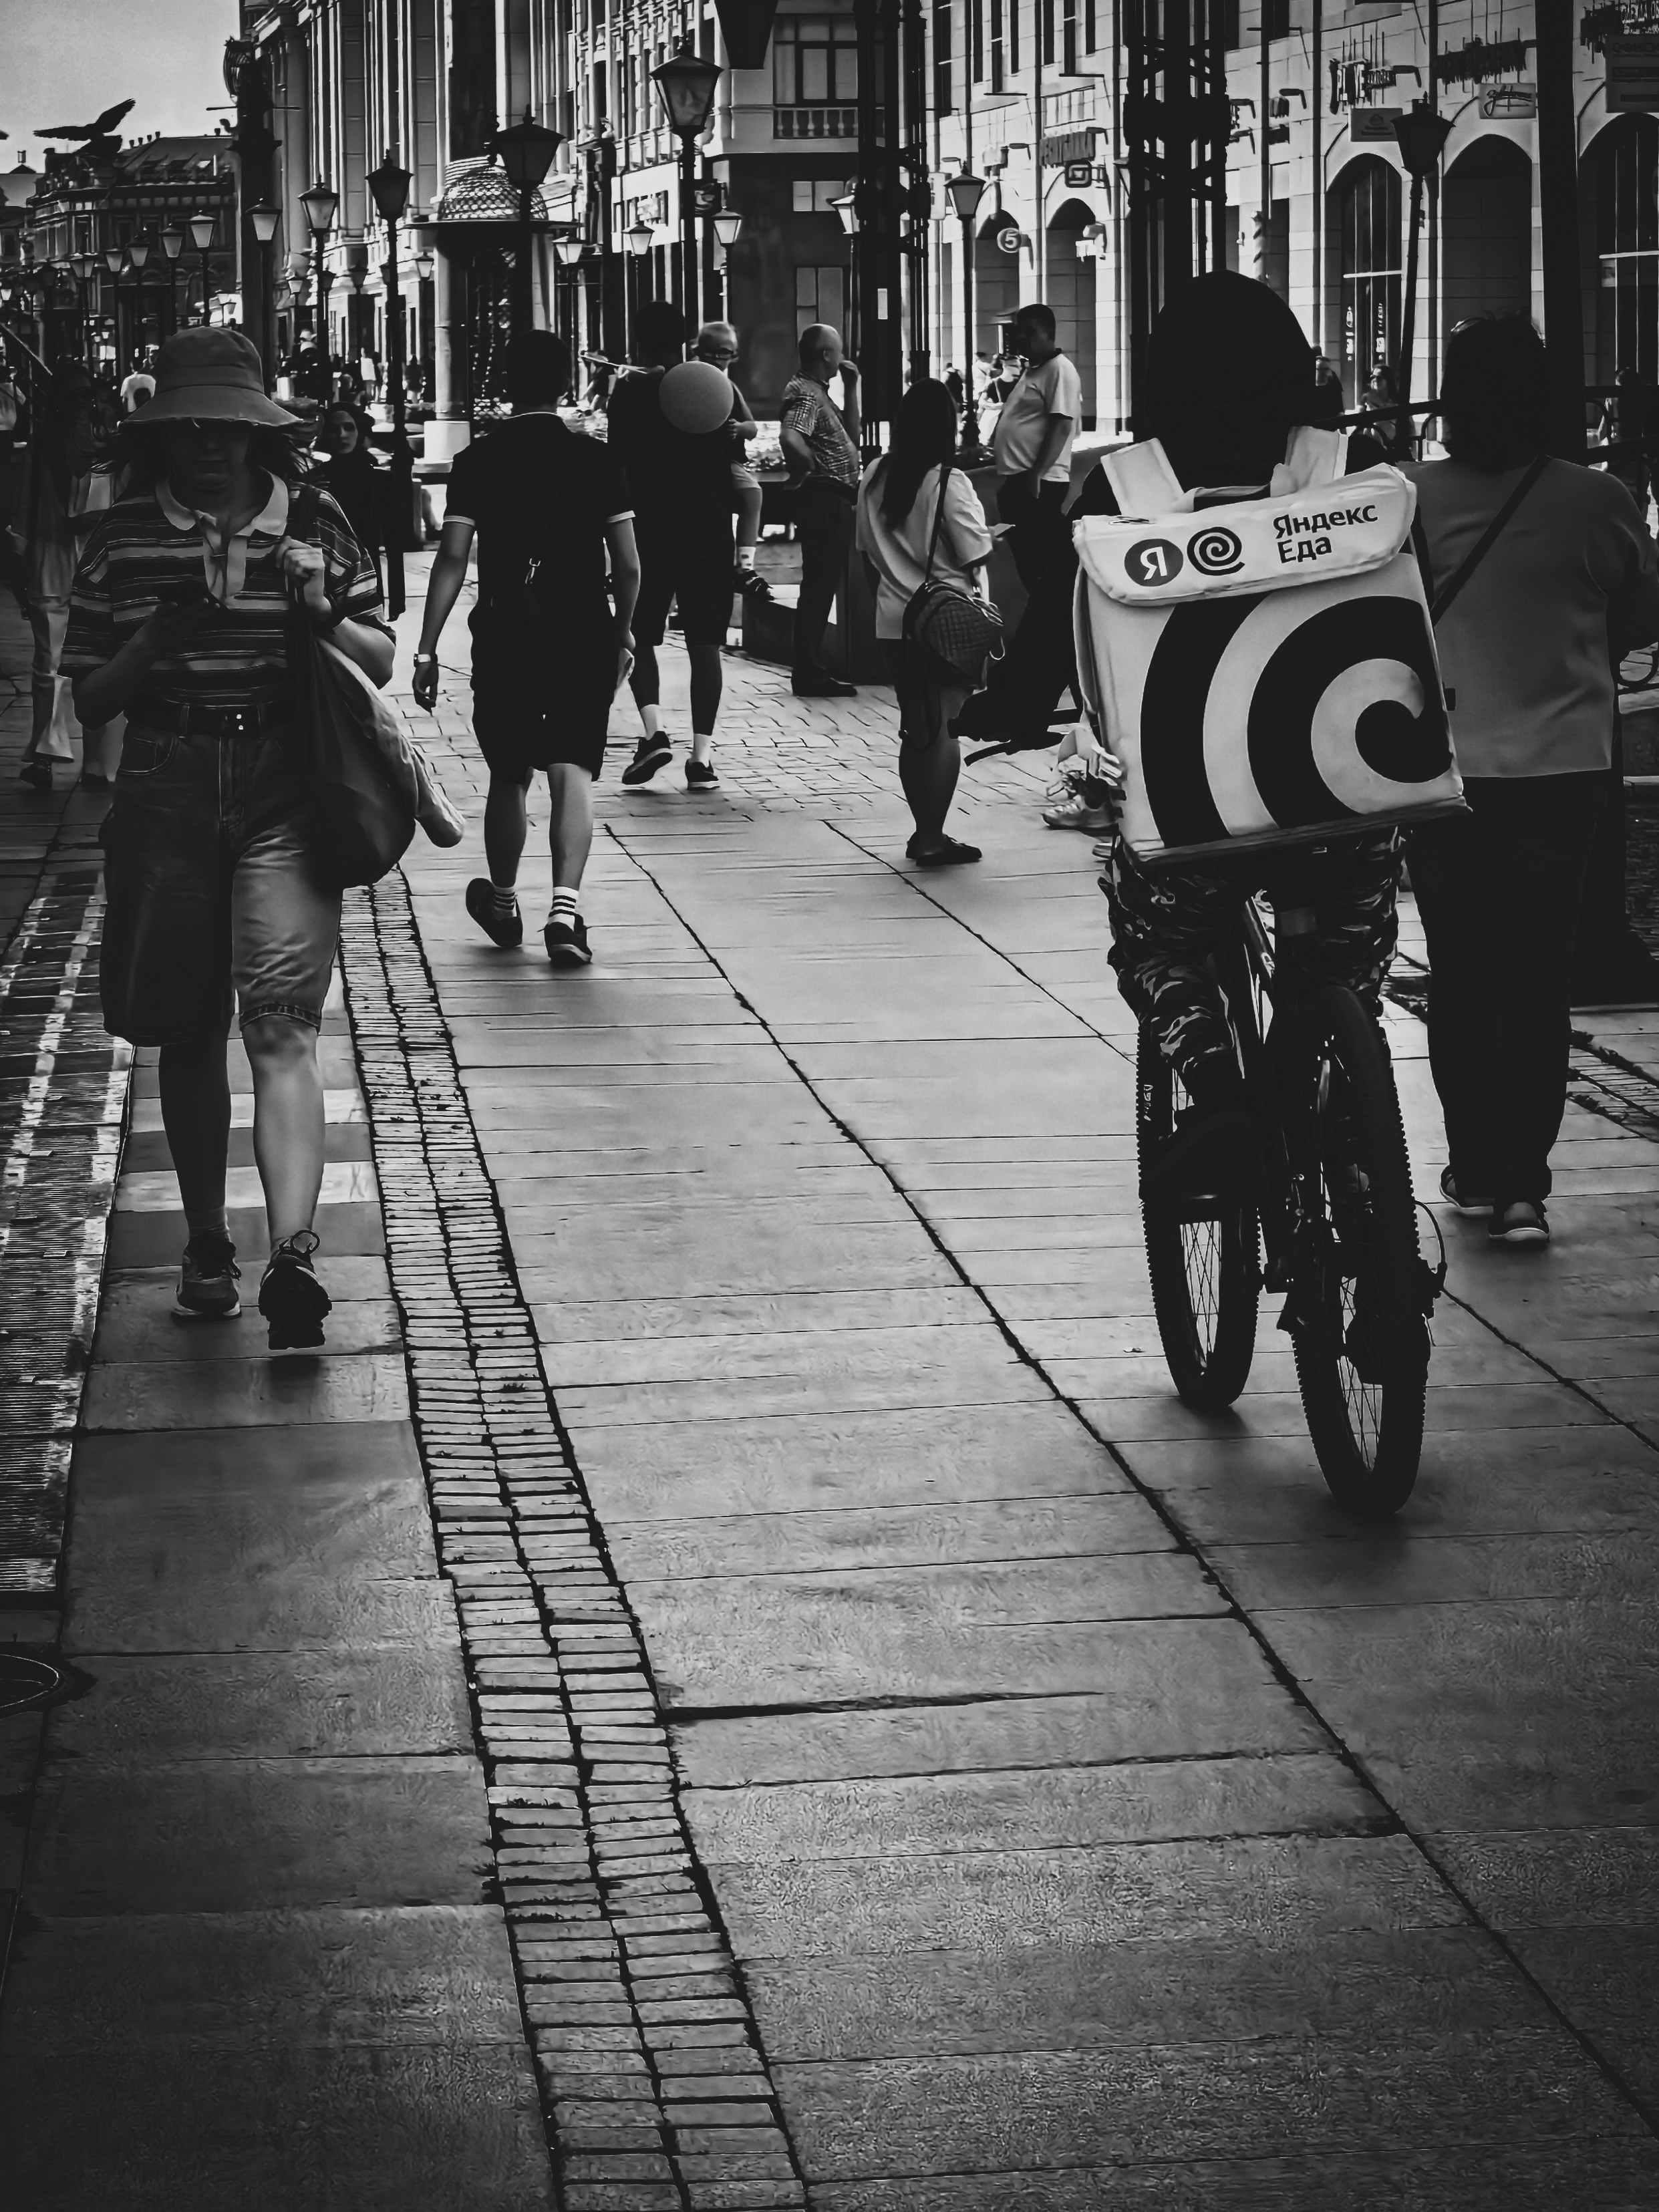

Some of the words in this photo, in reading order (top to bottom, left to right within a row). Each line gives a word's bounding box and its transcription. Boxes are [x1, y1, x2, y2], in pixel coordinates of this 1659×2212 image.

[1273, 505, 1378, 538] Яндекс
[1141, 546, 1169, 581] Я
[1277, 536, 1332, 564] Еда
